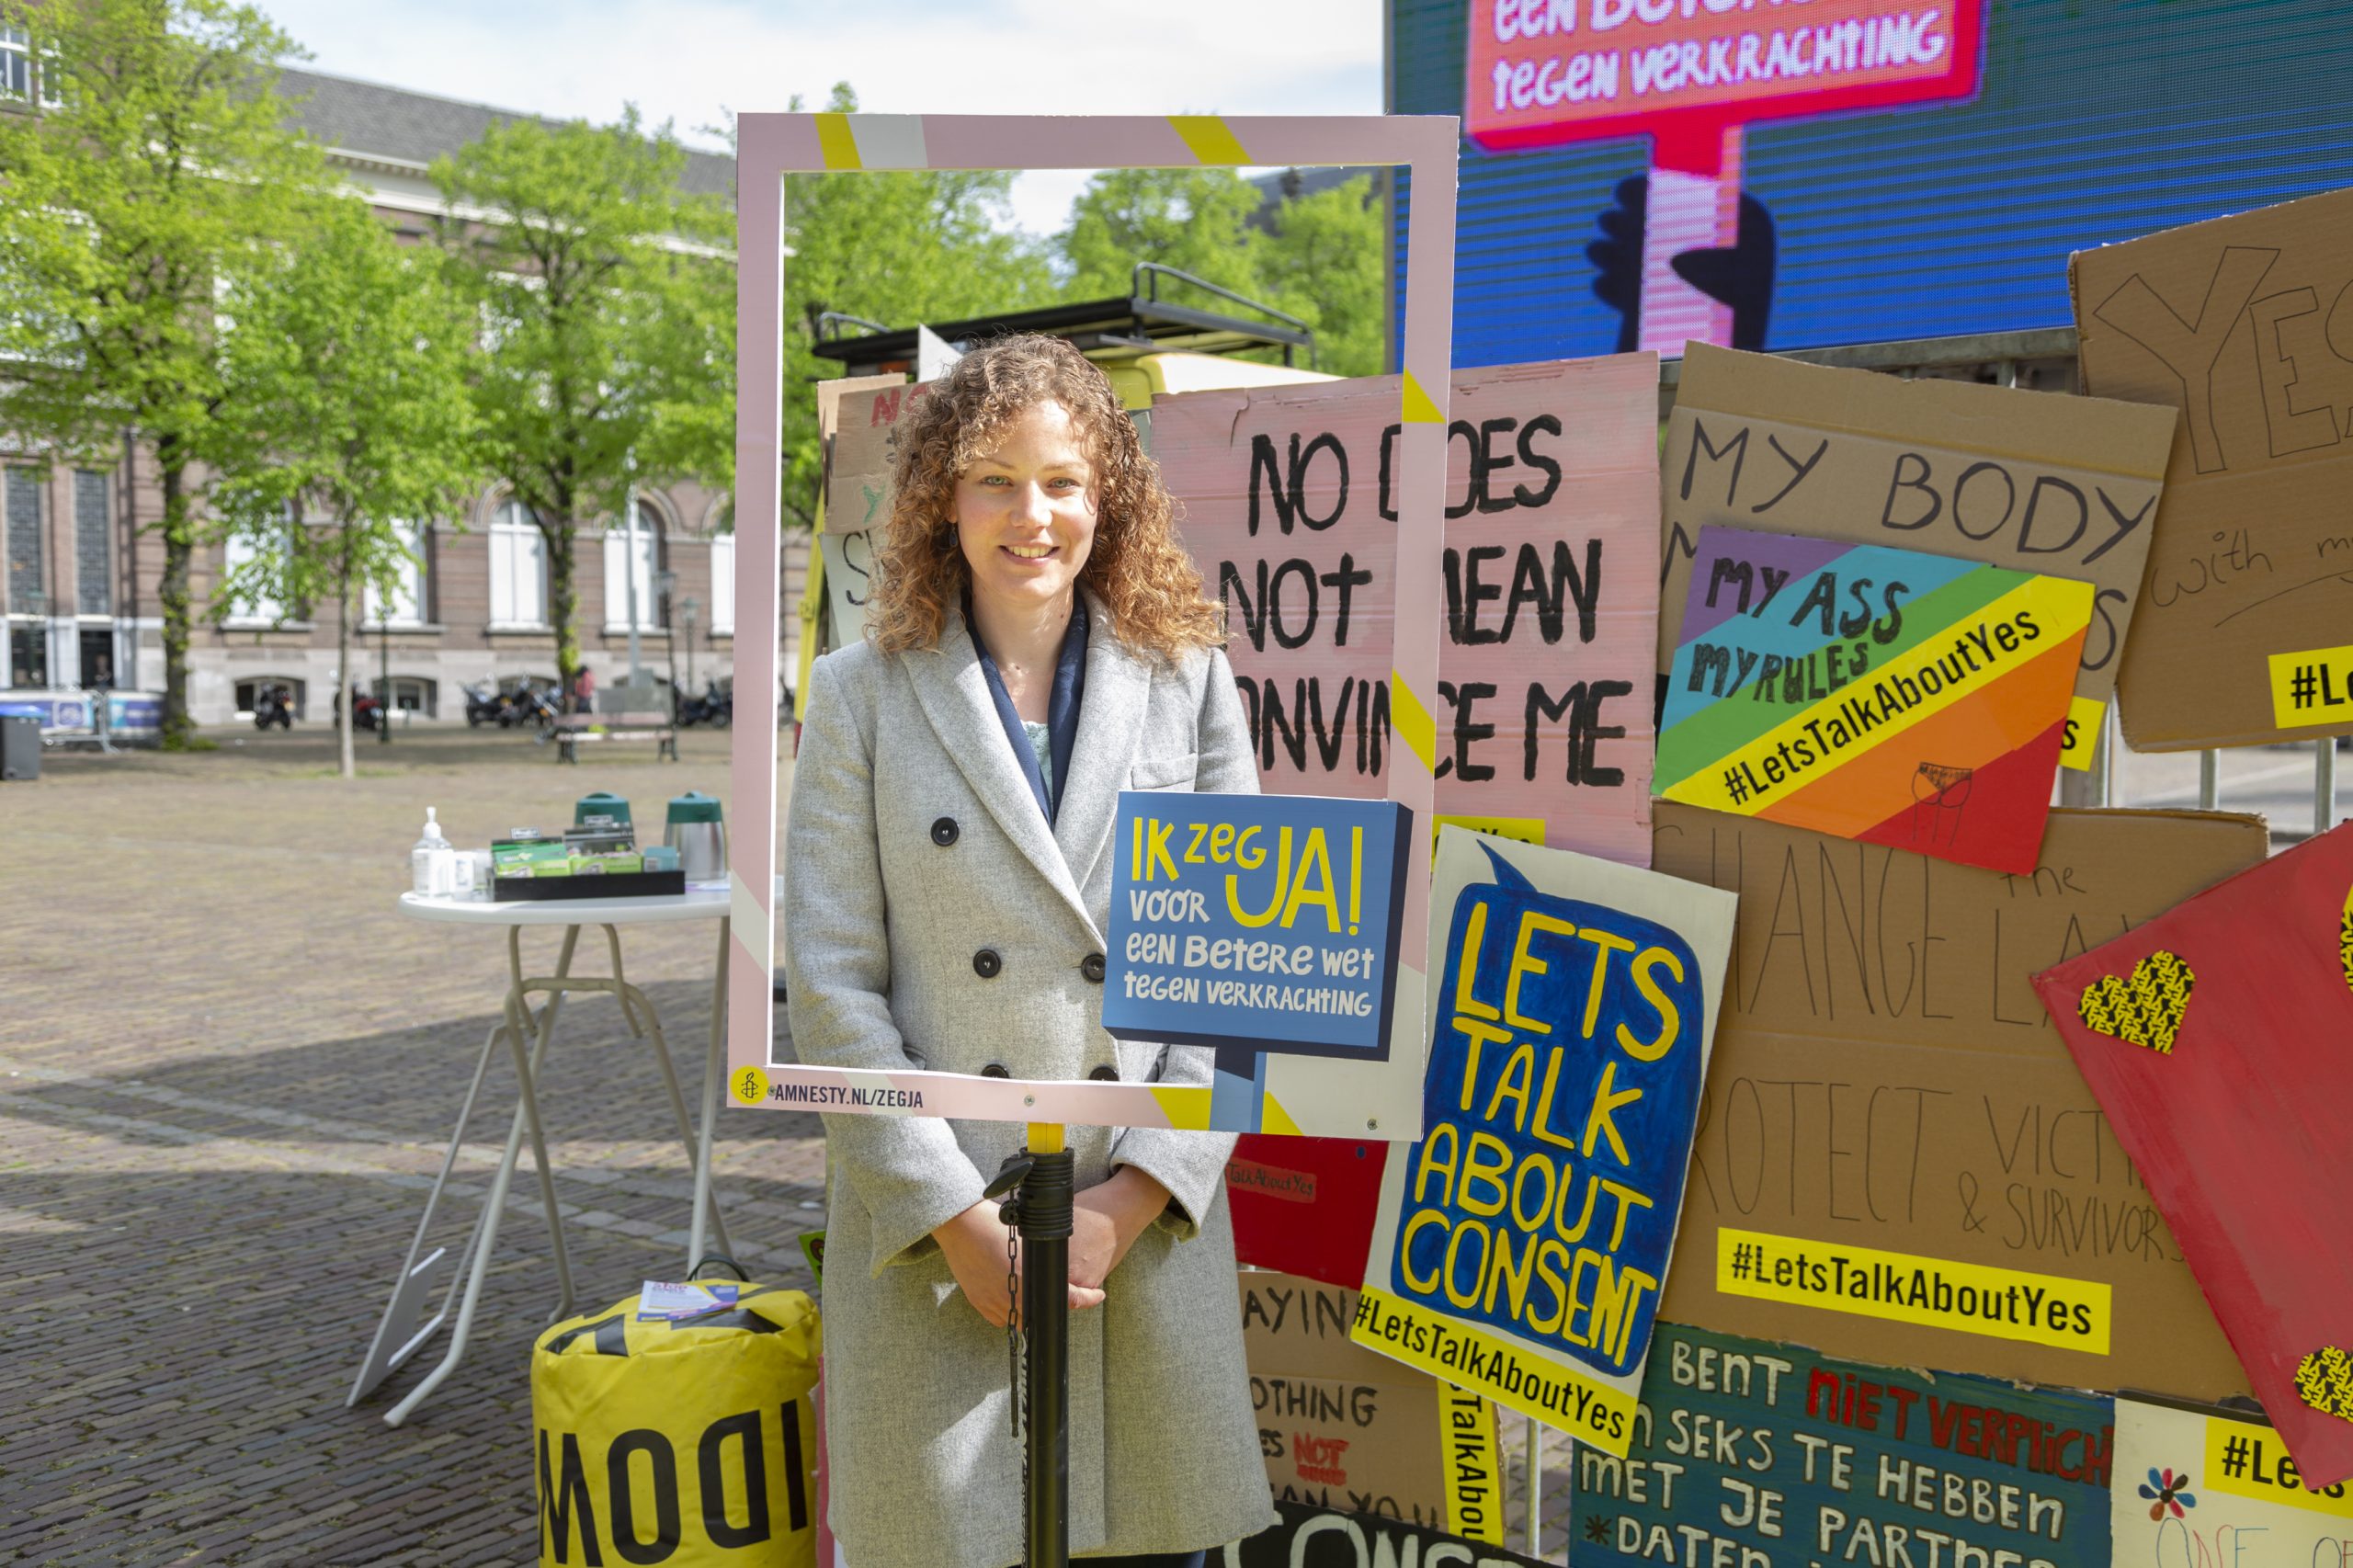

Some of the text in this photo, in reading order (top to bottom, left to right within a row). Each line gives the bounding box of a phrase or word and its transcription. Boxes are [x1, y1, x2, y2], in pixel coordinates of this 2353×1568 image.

[1248, 432, 1349, 536] NO
[1680, 416, 2156, 564] MY BODY
[1705, 557, 1790, 619] MY
[1789, 572, 1910, 644] ASS
[2151, 528, 2273, 608] with
[1524, 680, 1632, 786] ME
[1723, 610, 2040, 807] #LetsTalkAboutYes
[1131, 816, 1180, 882] IK
[1225, 826, 1363, 936] JA!
[1653, 824, 1954, 1021] HANGE
[1454, 901, 1685, 1063] LETS
[775, 1085, 924, 1108] AMNESTY.NL/ZEGJA
[1452, 1016, 1643, 1167] TALK
[1415, 1121, 1654, 1254] ABOUT
[2002, 1183, 2186, 1263] SURVIVOR
[1243, 1287, 1347, 1339] AYIN
[1400, 1208, 1658, 1369] CONSENT
[1732, 1240, 2093, 1336] #LetsTalkAboutYes
[1353, 1293, 1625, 1440] #LetsTalkAboutYes
[1293, 1431, 1349, 1470] NOT
[1665, 1409, 1773, 1471] SEKS
[1793, 1432, 1854, 1491] TE
[1720, 1476, 1784, 1538] JE
